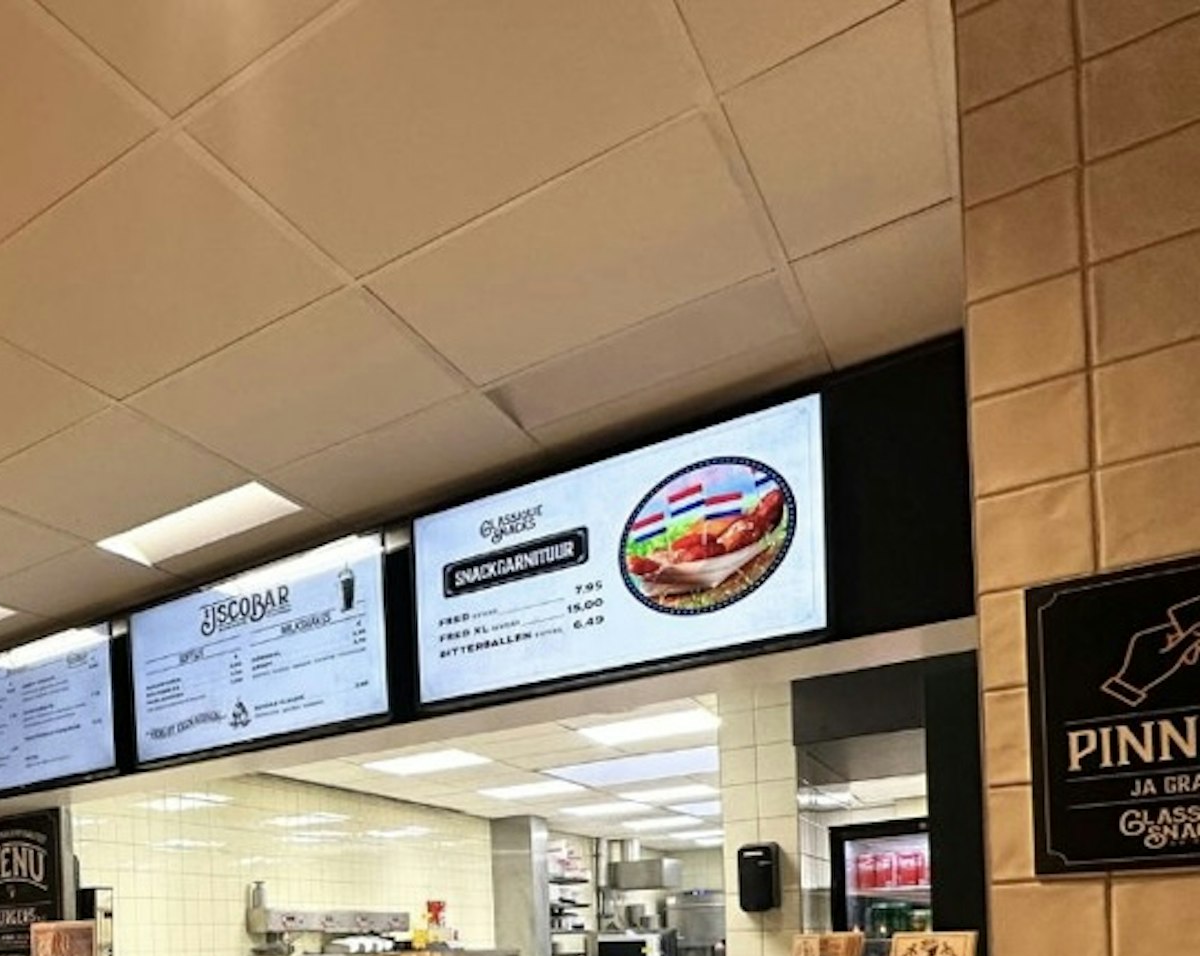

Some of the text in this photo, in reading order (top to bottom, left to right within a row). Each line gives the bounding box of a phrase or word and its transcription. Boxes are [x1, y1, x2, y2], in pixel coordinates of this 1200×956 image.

[438, 613, 470, 627] FRED
[574, 580, 603, 595] 7.95
[439, 598, 604, 643] FRED XL 15.00
[439, 632, 532, 659] BITTERBALLEN
[573, 615, 605, 630] 6.49
[1130, 778, 1157, 797] JA
[1144, 822, 1200, 849] SNA
